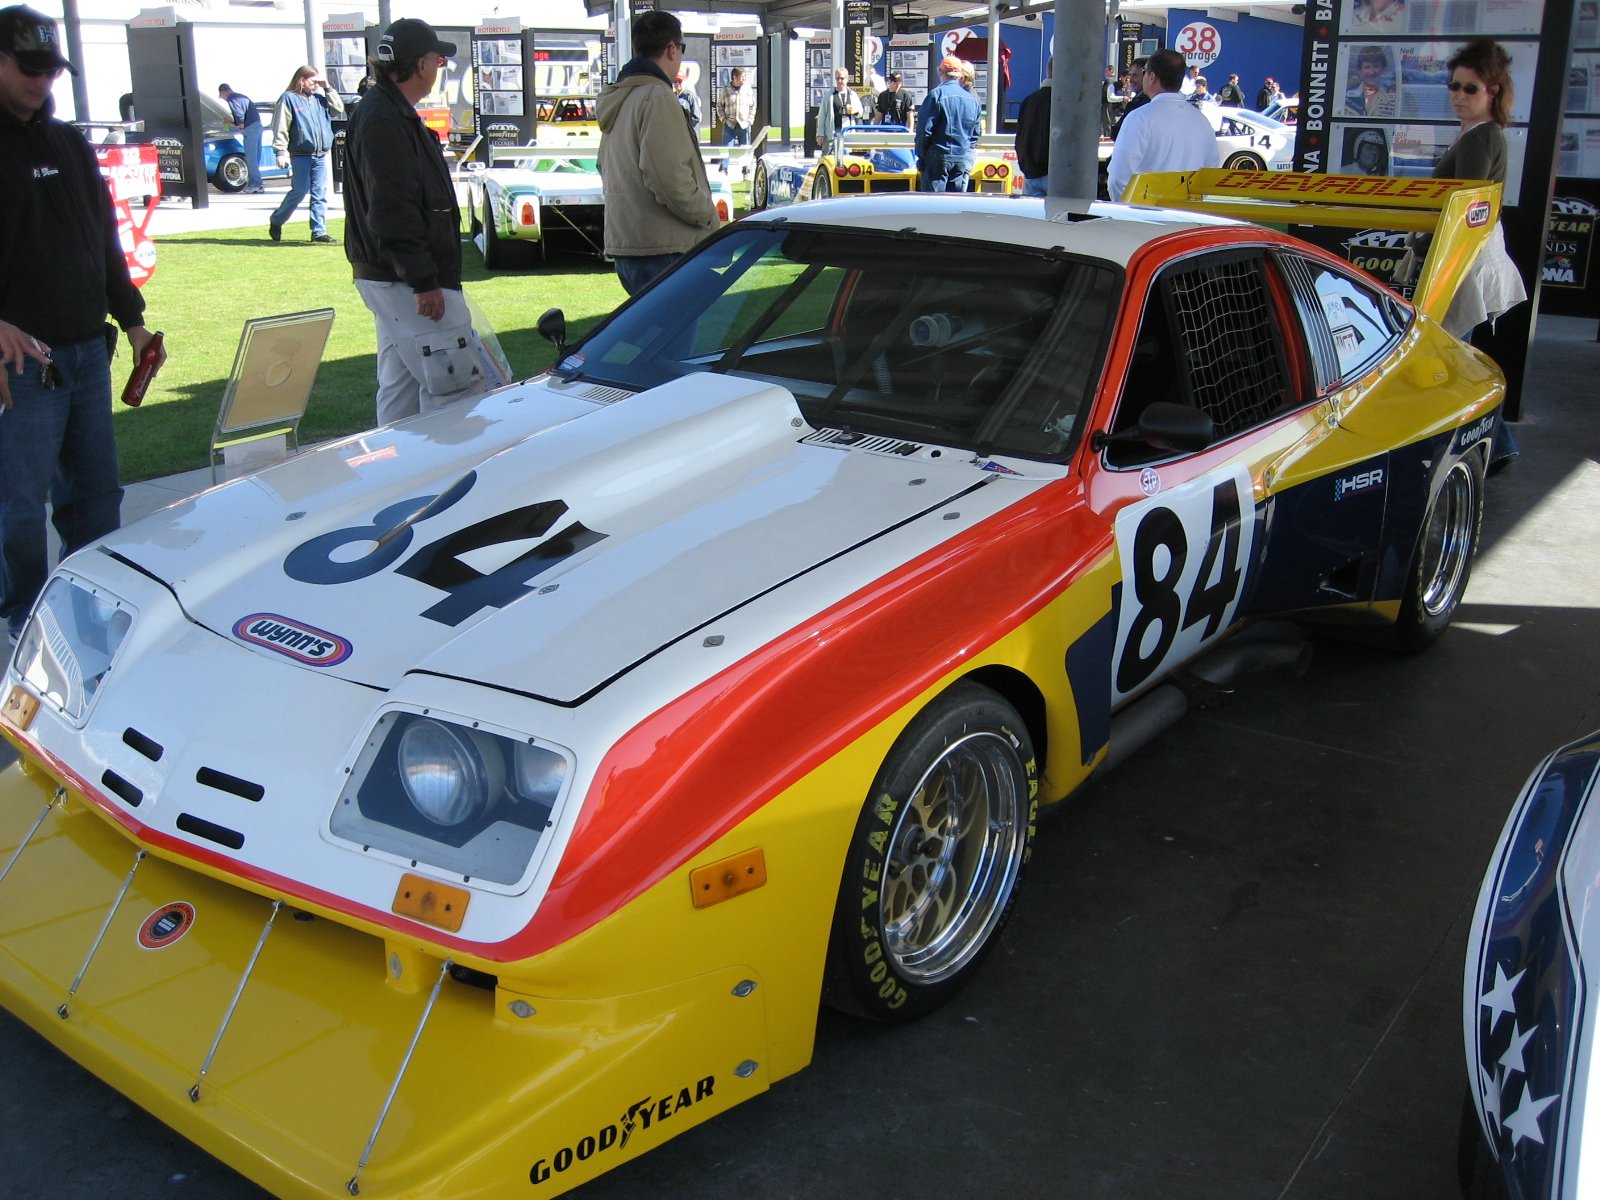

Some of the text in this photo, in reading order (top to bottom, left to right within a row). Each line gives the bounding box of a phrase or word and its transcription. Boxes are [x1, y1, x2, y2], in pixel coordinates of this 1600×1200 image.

[854, 30, 864, 84] GOODYEAR
[1180, 27, 1216, 53] 38
[1182, 51, 1217, 63] garage
[1305, 40, 1330, 131] BONNETT
[1249, 135, 1271, 149] 14
[861, 164, 873, 175] 14
[1215, 171, 1465, 199] CHEVROLET
[1341, 468, 1383, 494] HSR
[284, 469, 611, 627] 84
[1116, 477, 1242, 694] 84
[860, 792, 908, 1010] GOODYEAR
[529, 1075, 715, 1185] GOODYEAR
